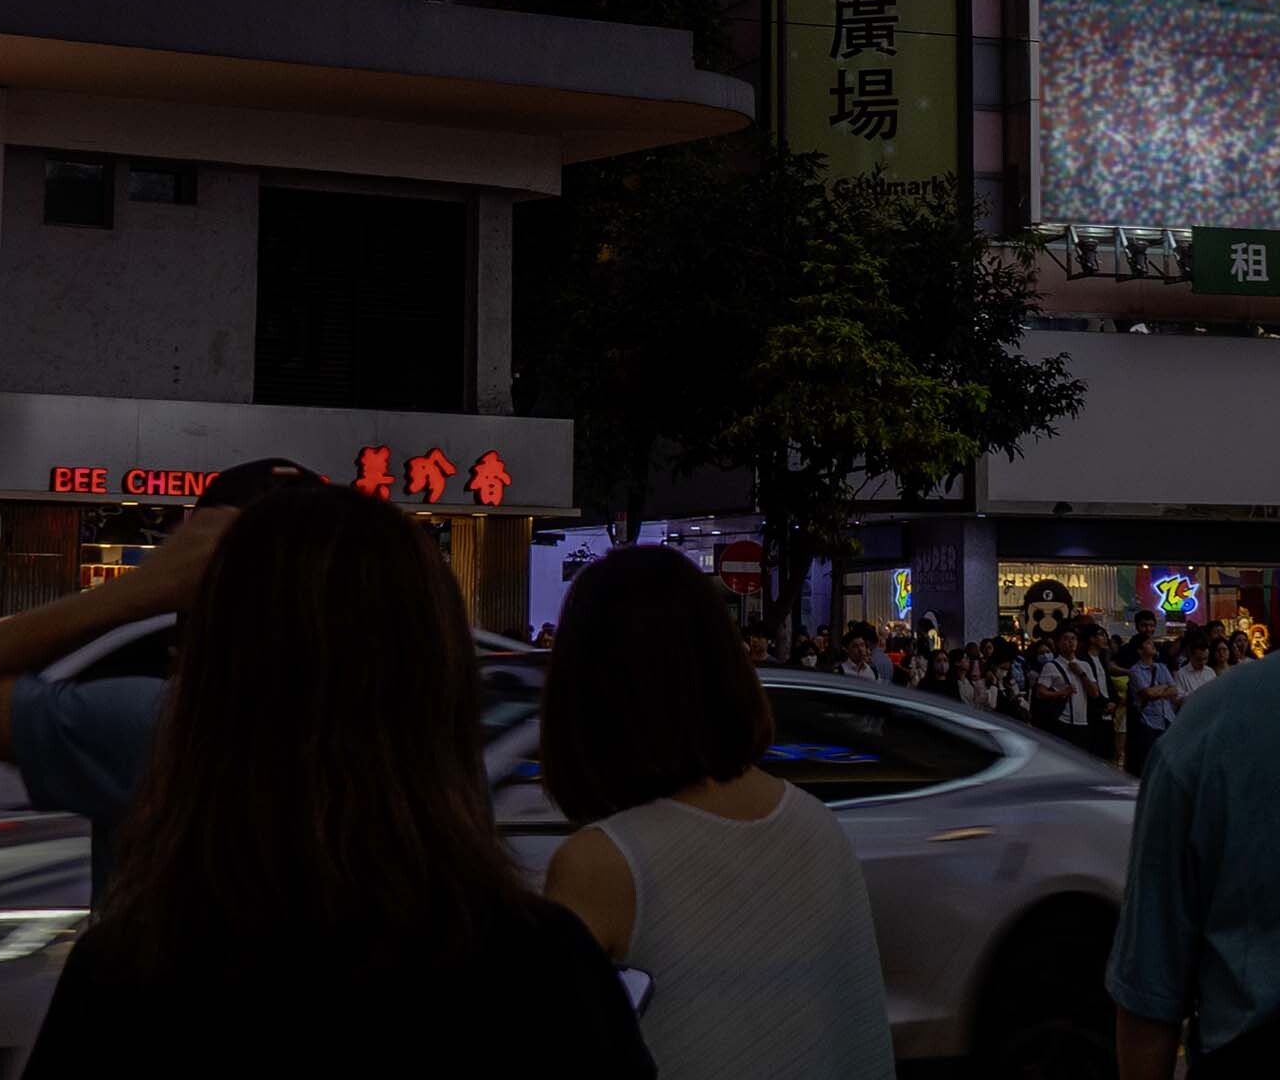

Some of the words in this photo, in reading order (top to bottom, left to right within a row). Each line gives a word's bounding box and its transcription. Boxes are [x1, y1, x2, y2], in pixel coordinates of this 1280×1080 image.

[53, 467, 109, 494] BEE
[352, 445, 512, 507] 美珍香
